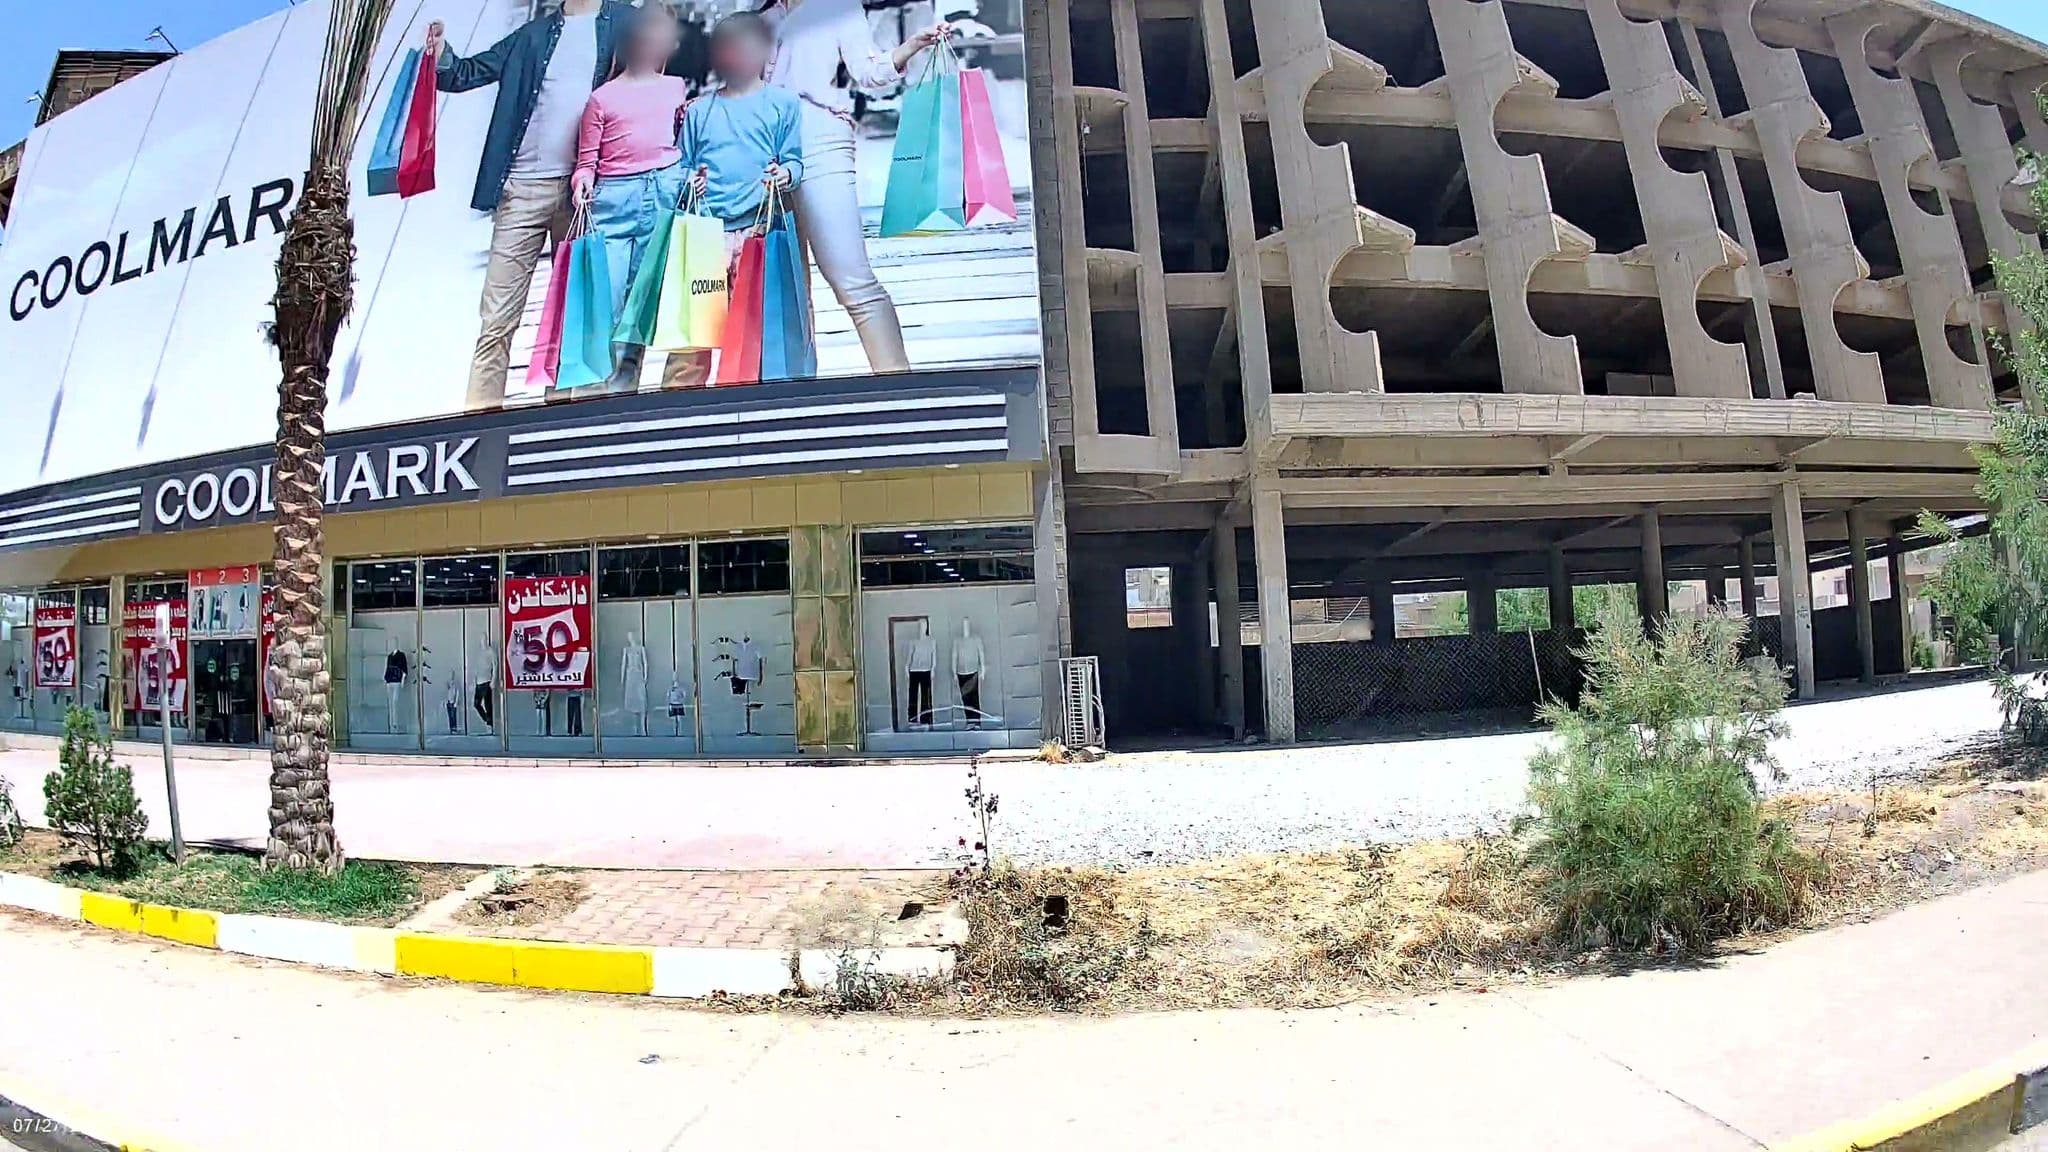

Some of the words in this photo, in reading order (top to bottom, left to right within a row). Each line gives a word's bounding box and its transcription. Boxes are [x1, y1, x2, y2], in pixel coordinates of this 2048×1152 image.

[10, 171, 311, 321] COOLMAR
[691, 280, 726, 295] COOLMARK
[196, 571, 202, 585] 1
[218, 570, 226, 584] 2
[242, 568, 250, 582] 3
